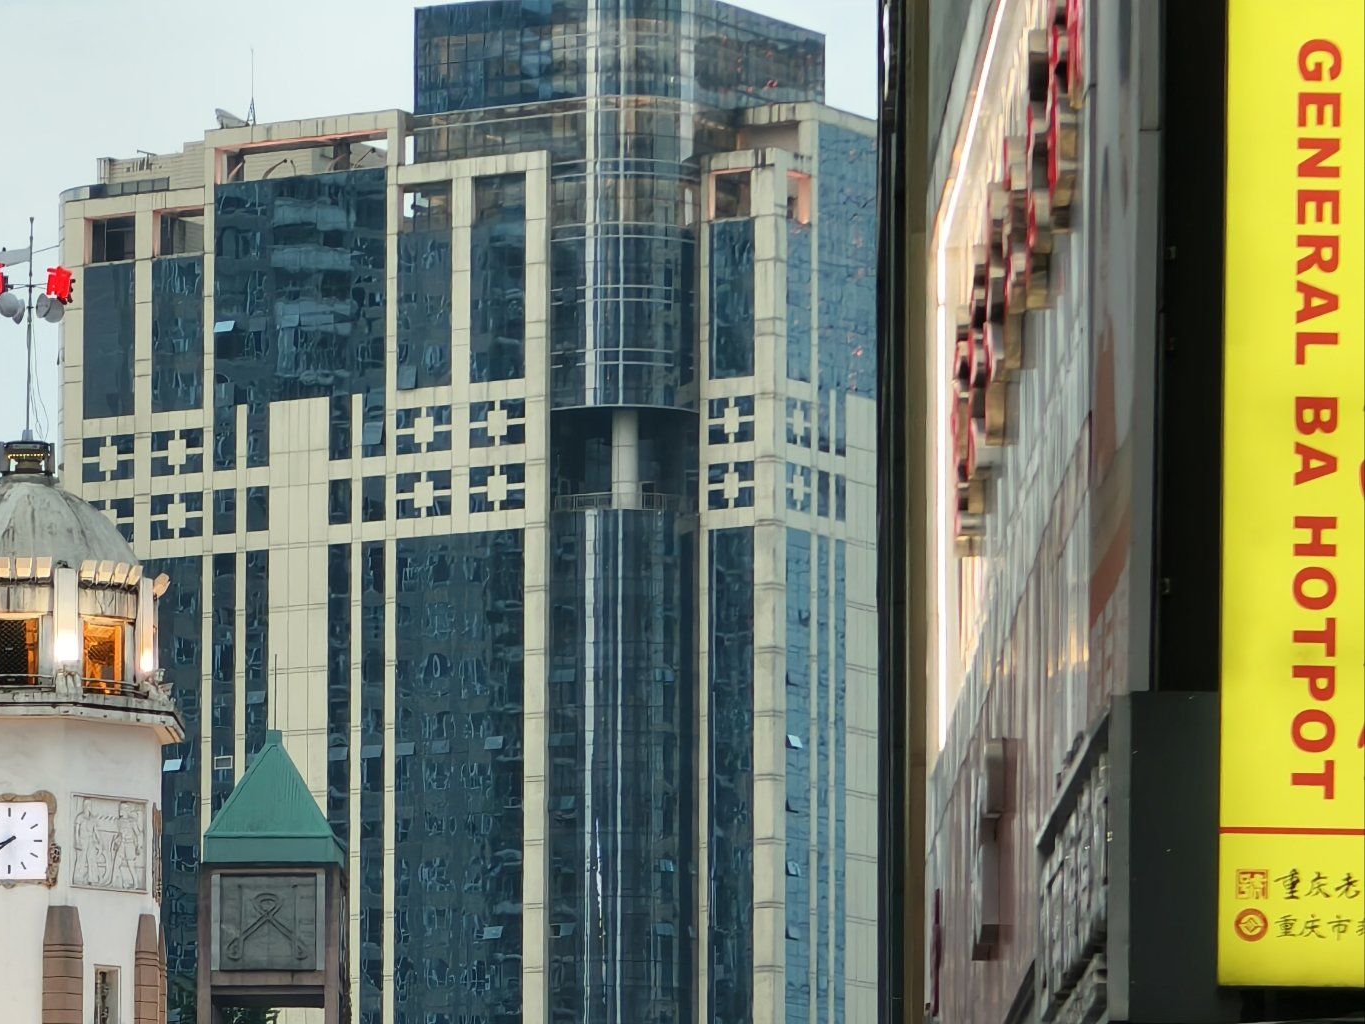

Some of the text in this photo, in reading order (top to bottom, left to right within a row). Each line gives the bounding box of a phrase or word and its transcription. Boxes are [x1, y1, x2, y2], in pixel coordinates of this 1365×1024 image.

[1290, 38, 1343, 800] GENERAL BA HOTPOT
